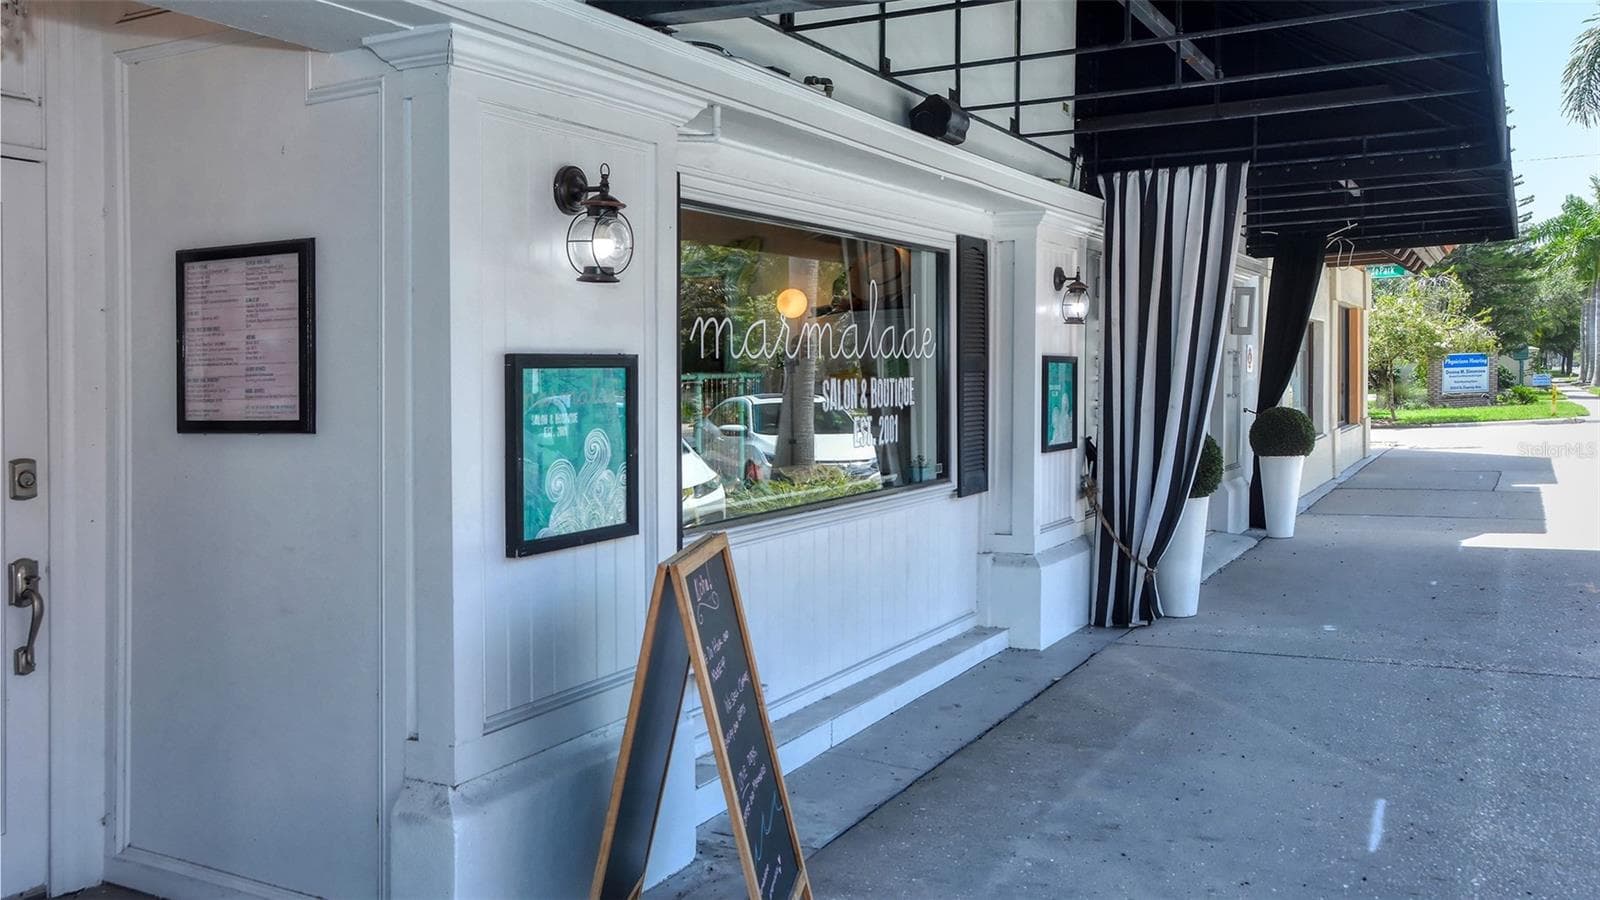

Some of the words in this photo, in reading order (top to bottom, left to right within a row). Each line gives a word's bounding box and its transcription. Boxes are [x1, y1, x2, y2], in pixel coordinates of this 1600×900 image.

[689, 279, 936, 359] marmalade
[822, 377, 858, 412] SALON
[860, 378, 868, 409] &
[870, 376, 915, 410] BOUTIQUE
[853, 415, 877, 448] EST.
[879, 414, 899, 446] 2001
